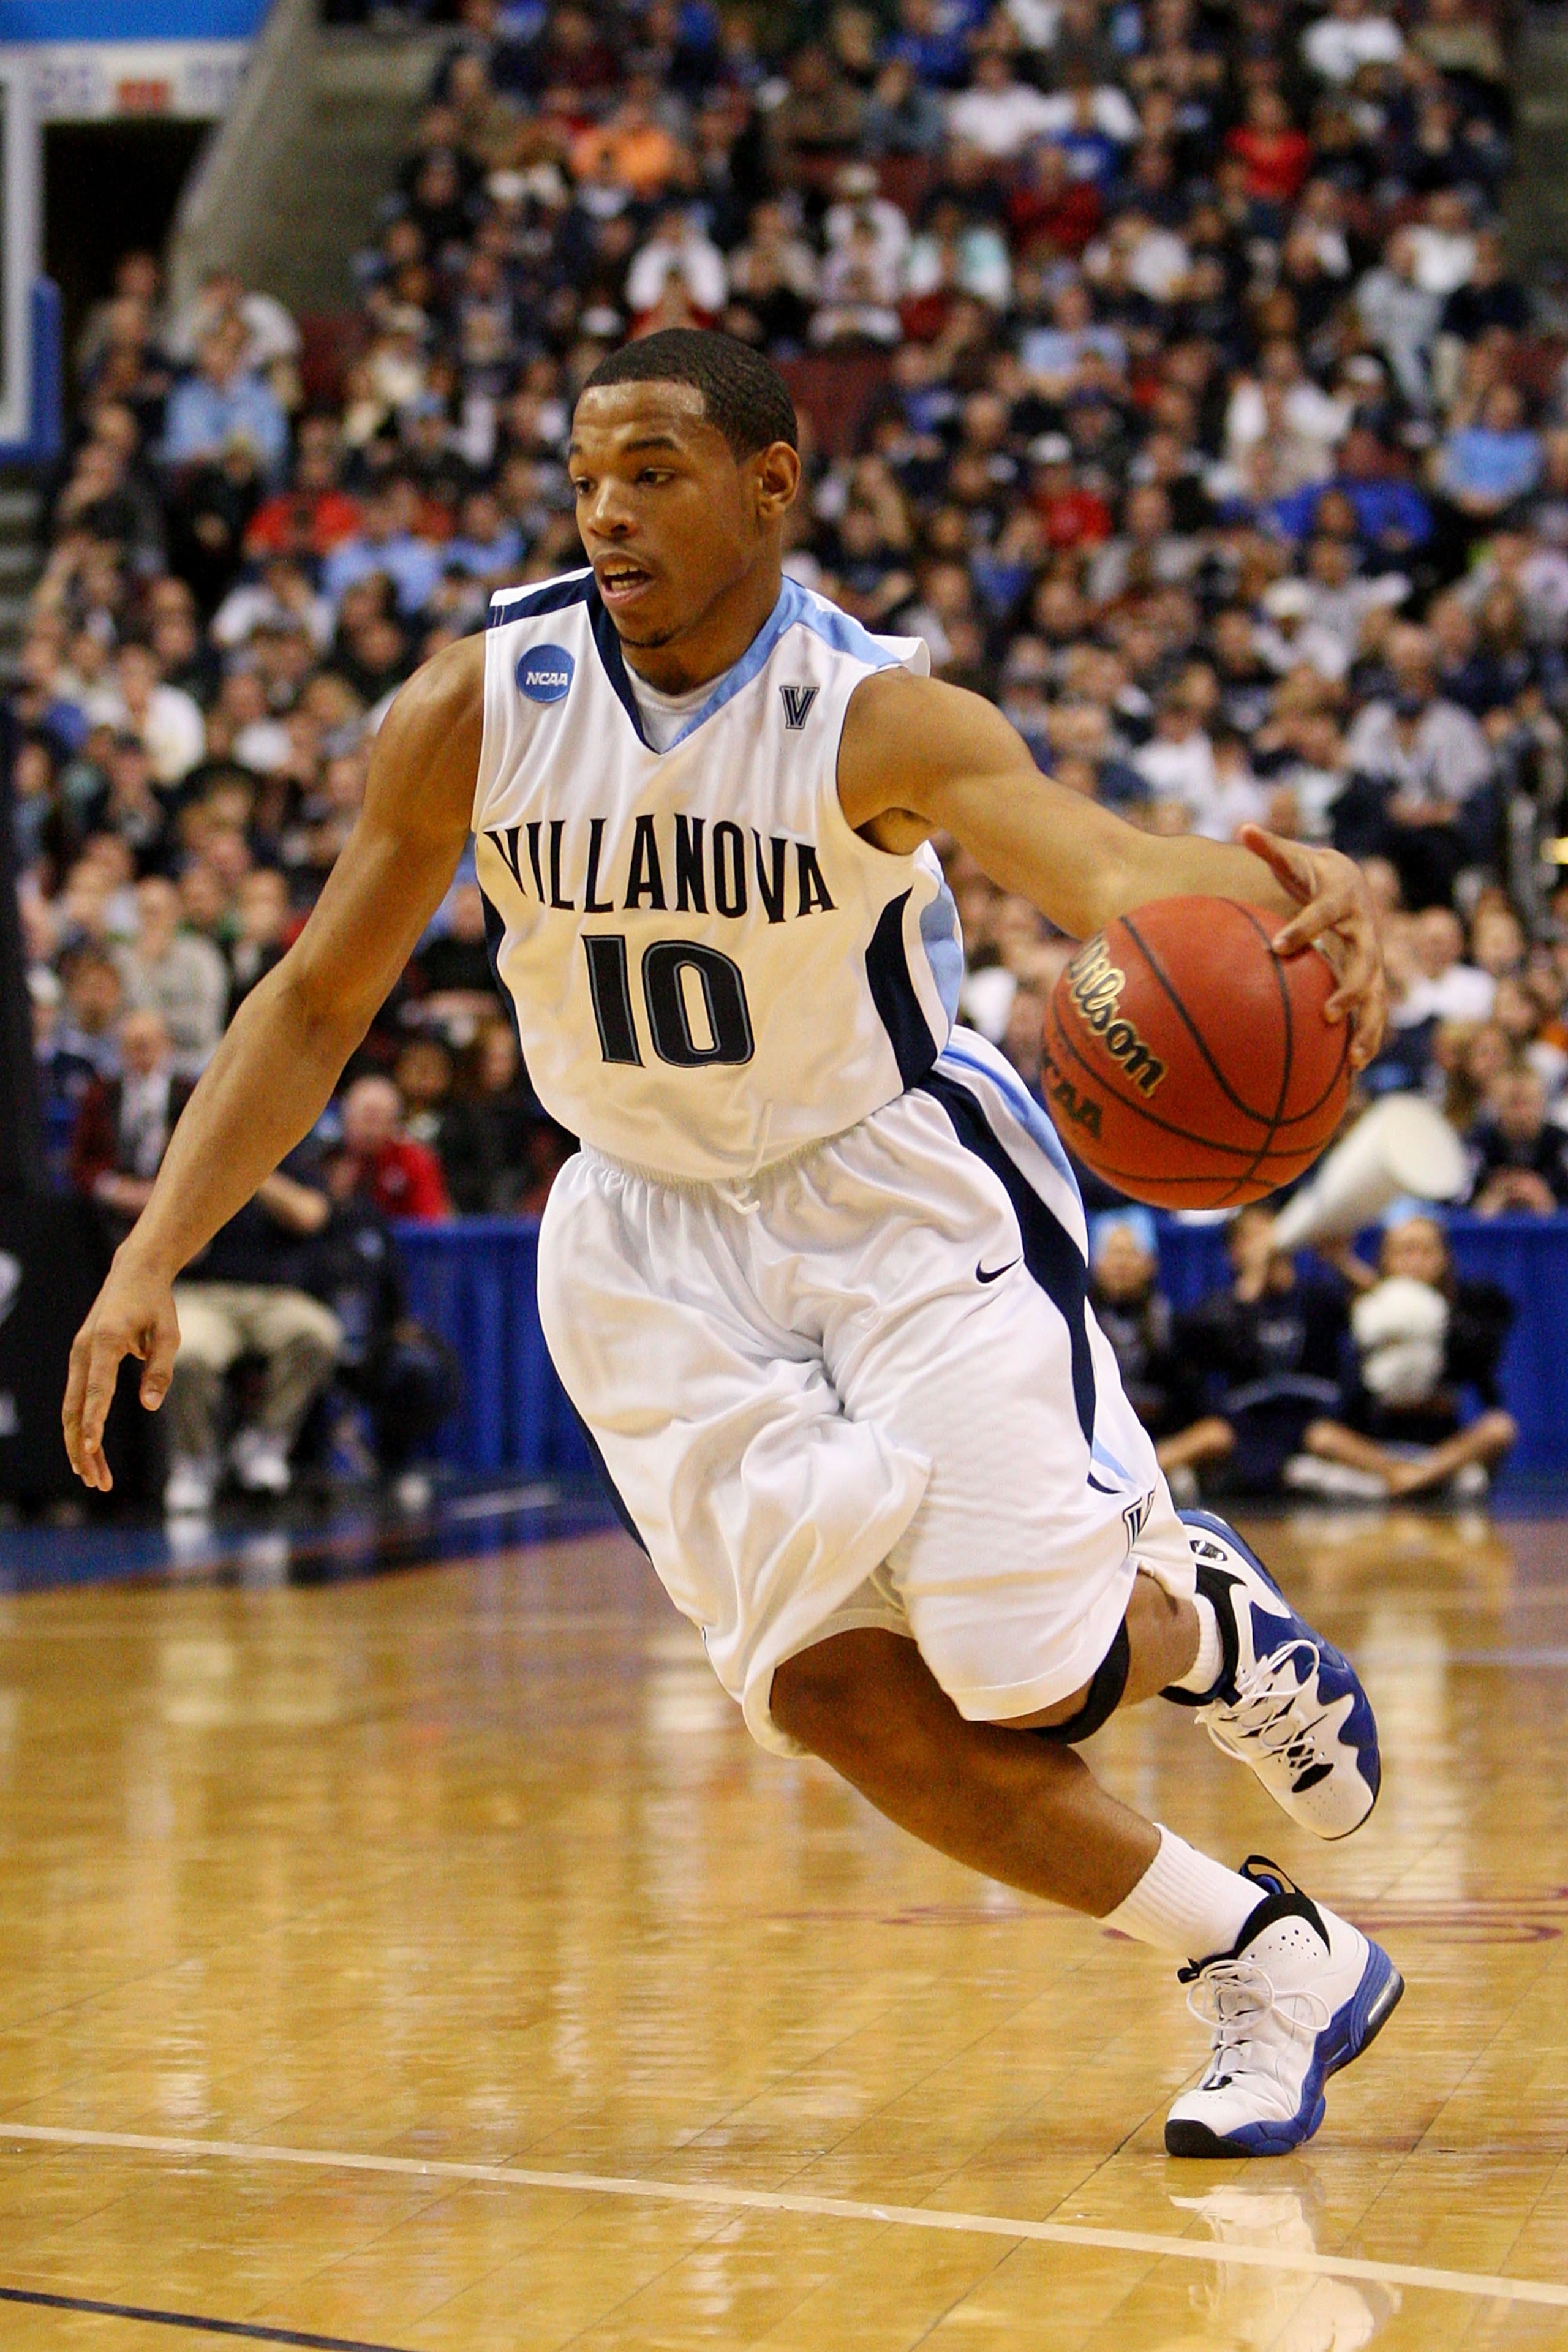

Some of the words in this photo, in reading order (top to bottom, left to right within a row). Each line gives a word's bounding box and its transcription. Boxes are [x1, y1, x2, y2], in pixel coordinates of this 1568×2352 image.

[526, 671, 568, 687] NCAA
[780, 685, 820, 730] V
[483, 814, 840, 924] VILLANOVA
[581, 934, 756, 1068] 10
